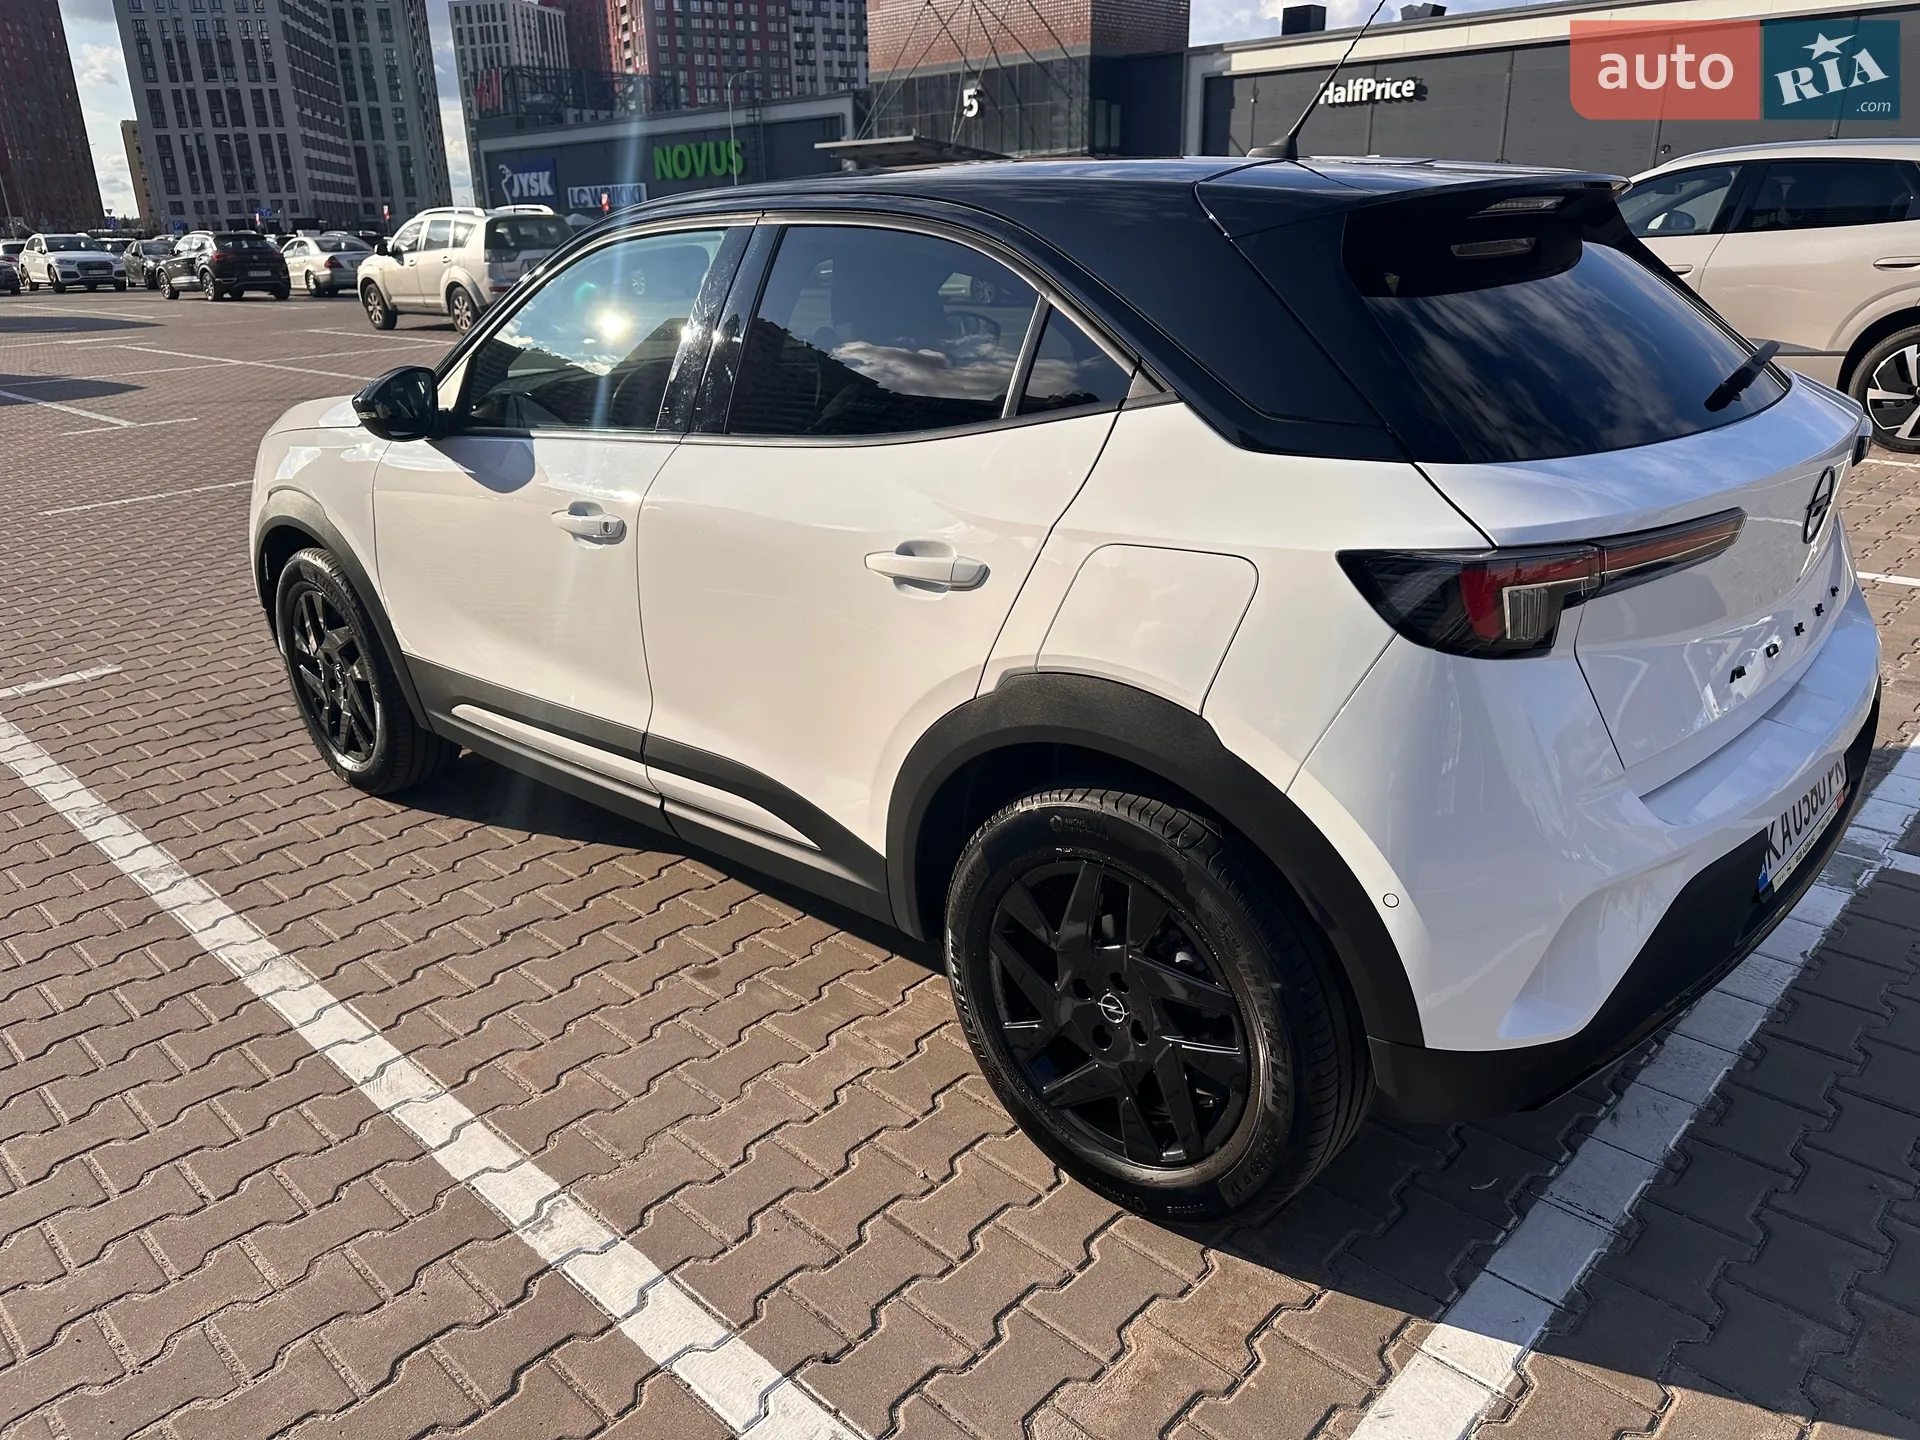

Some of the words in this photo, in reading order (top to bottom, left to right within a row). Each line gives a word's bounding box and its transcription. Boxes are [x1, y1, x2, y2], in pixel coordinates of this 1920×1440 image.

[963, 88, 979, 117] 5
[1319, 78, 1416, 105] HalfPrice
[654, 138, 744, 180] NOVUS
[512, 170, 554, 198] JYSK
[1238, 957, 1290, 1118] MICHELIN
